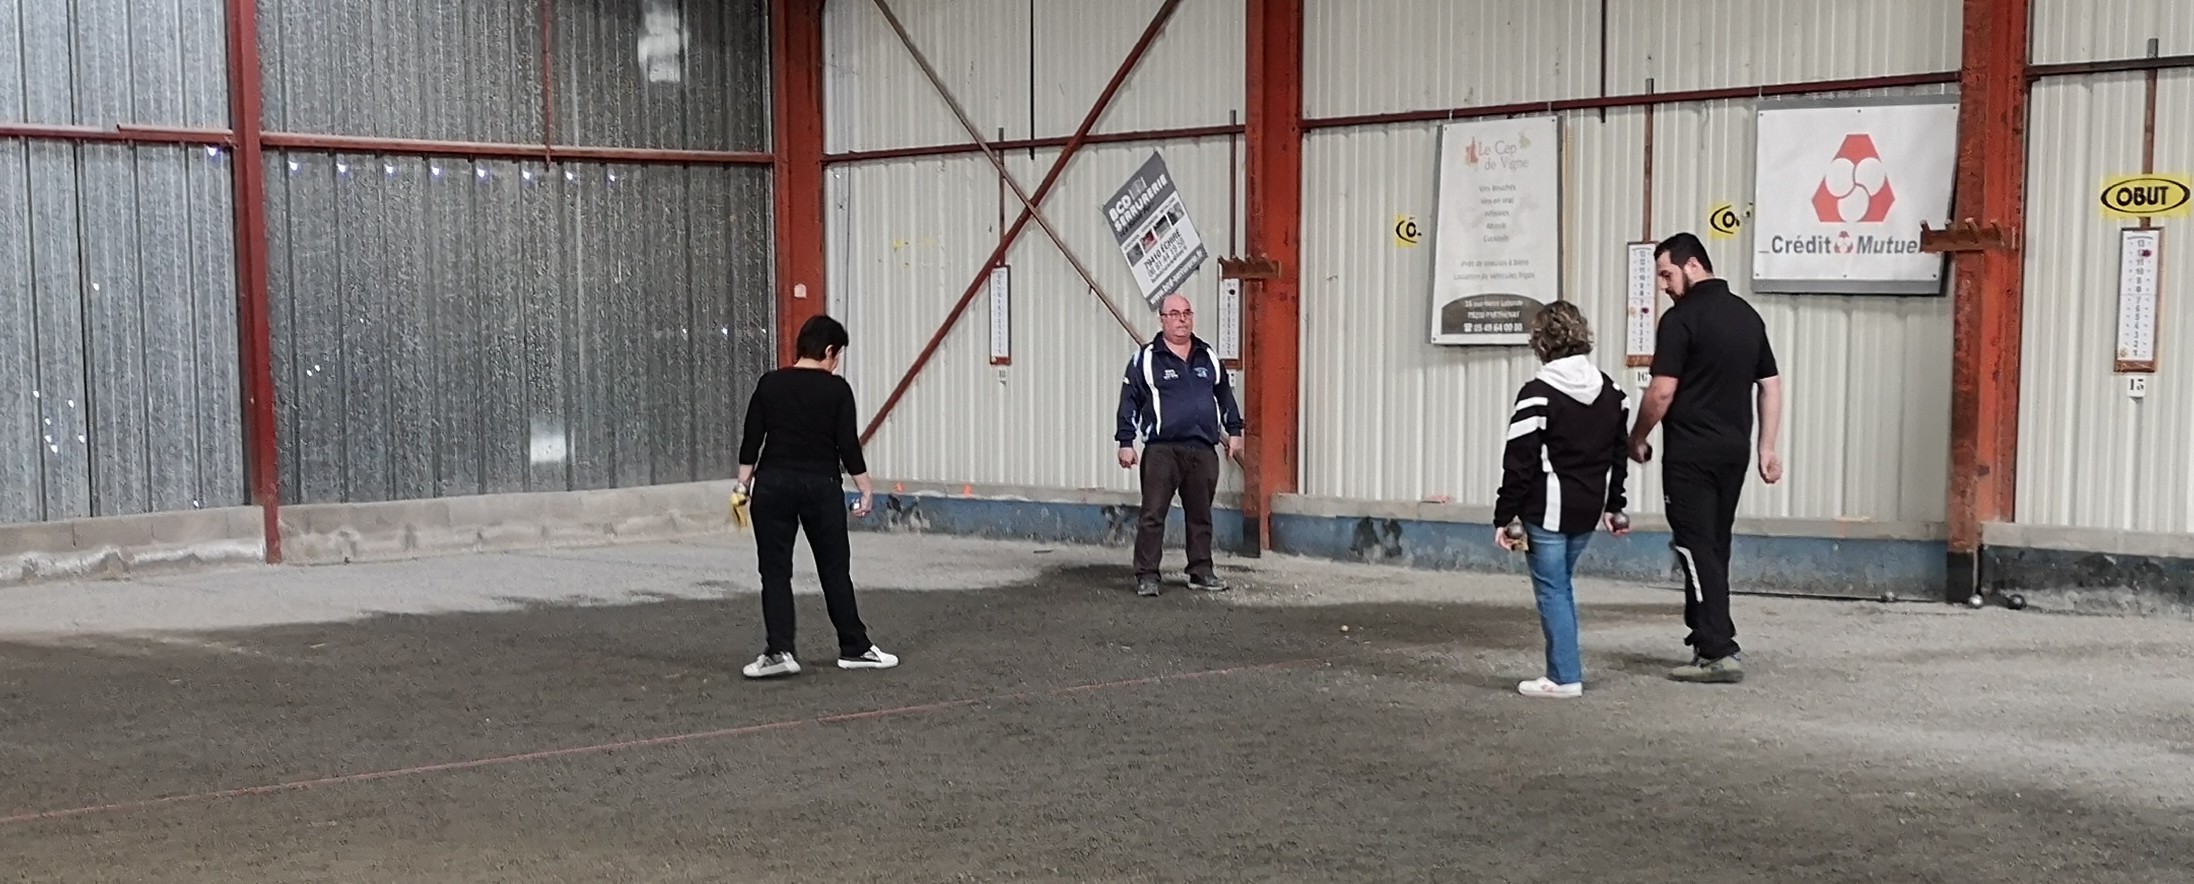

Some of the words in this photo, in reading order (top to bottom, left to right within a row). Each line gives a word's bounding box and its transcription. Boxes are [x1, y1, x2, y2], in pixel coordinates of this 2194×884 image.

[1478, 141, 1491, 156] Le
[1494, 140, 1517, 156] Cep
[1484, 157, 1496, 171] de
[1500, 156, 1529, 171] Vigne
[1114, 174, 1168, 232] SERRURERIE
[2115, 185, 2169, 207] OBUT
[1109, 195, 1132, 222] BCD
[1772, 234, 1831, 254] Crédit
[1857, 235, 1920, 254] Mutue
[2129, 378, 2145, 391] 15
